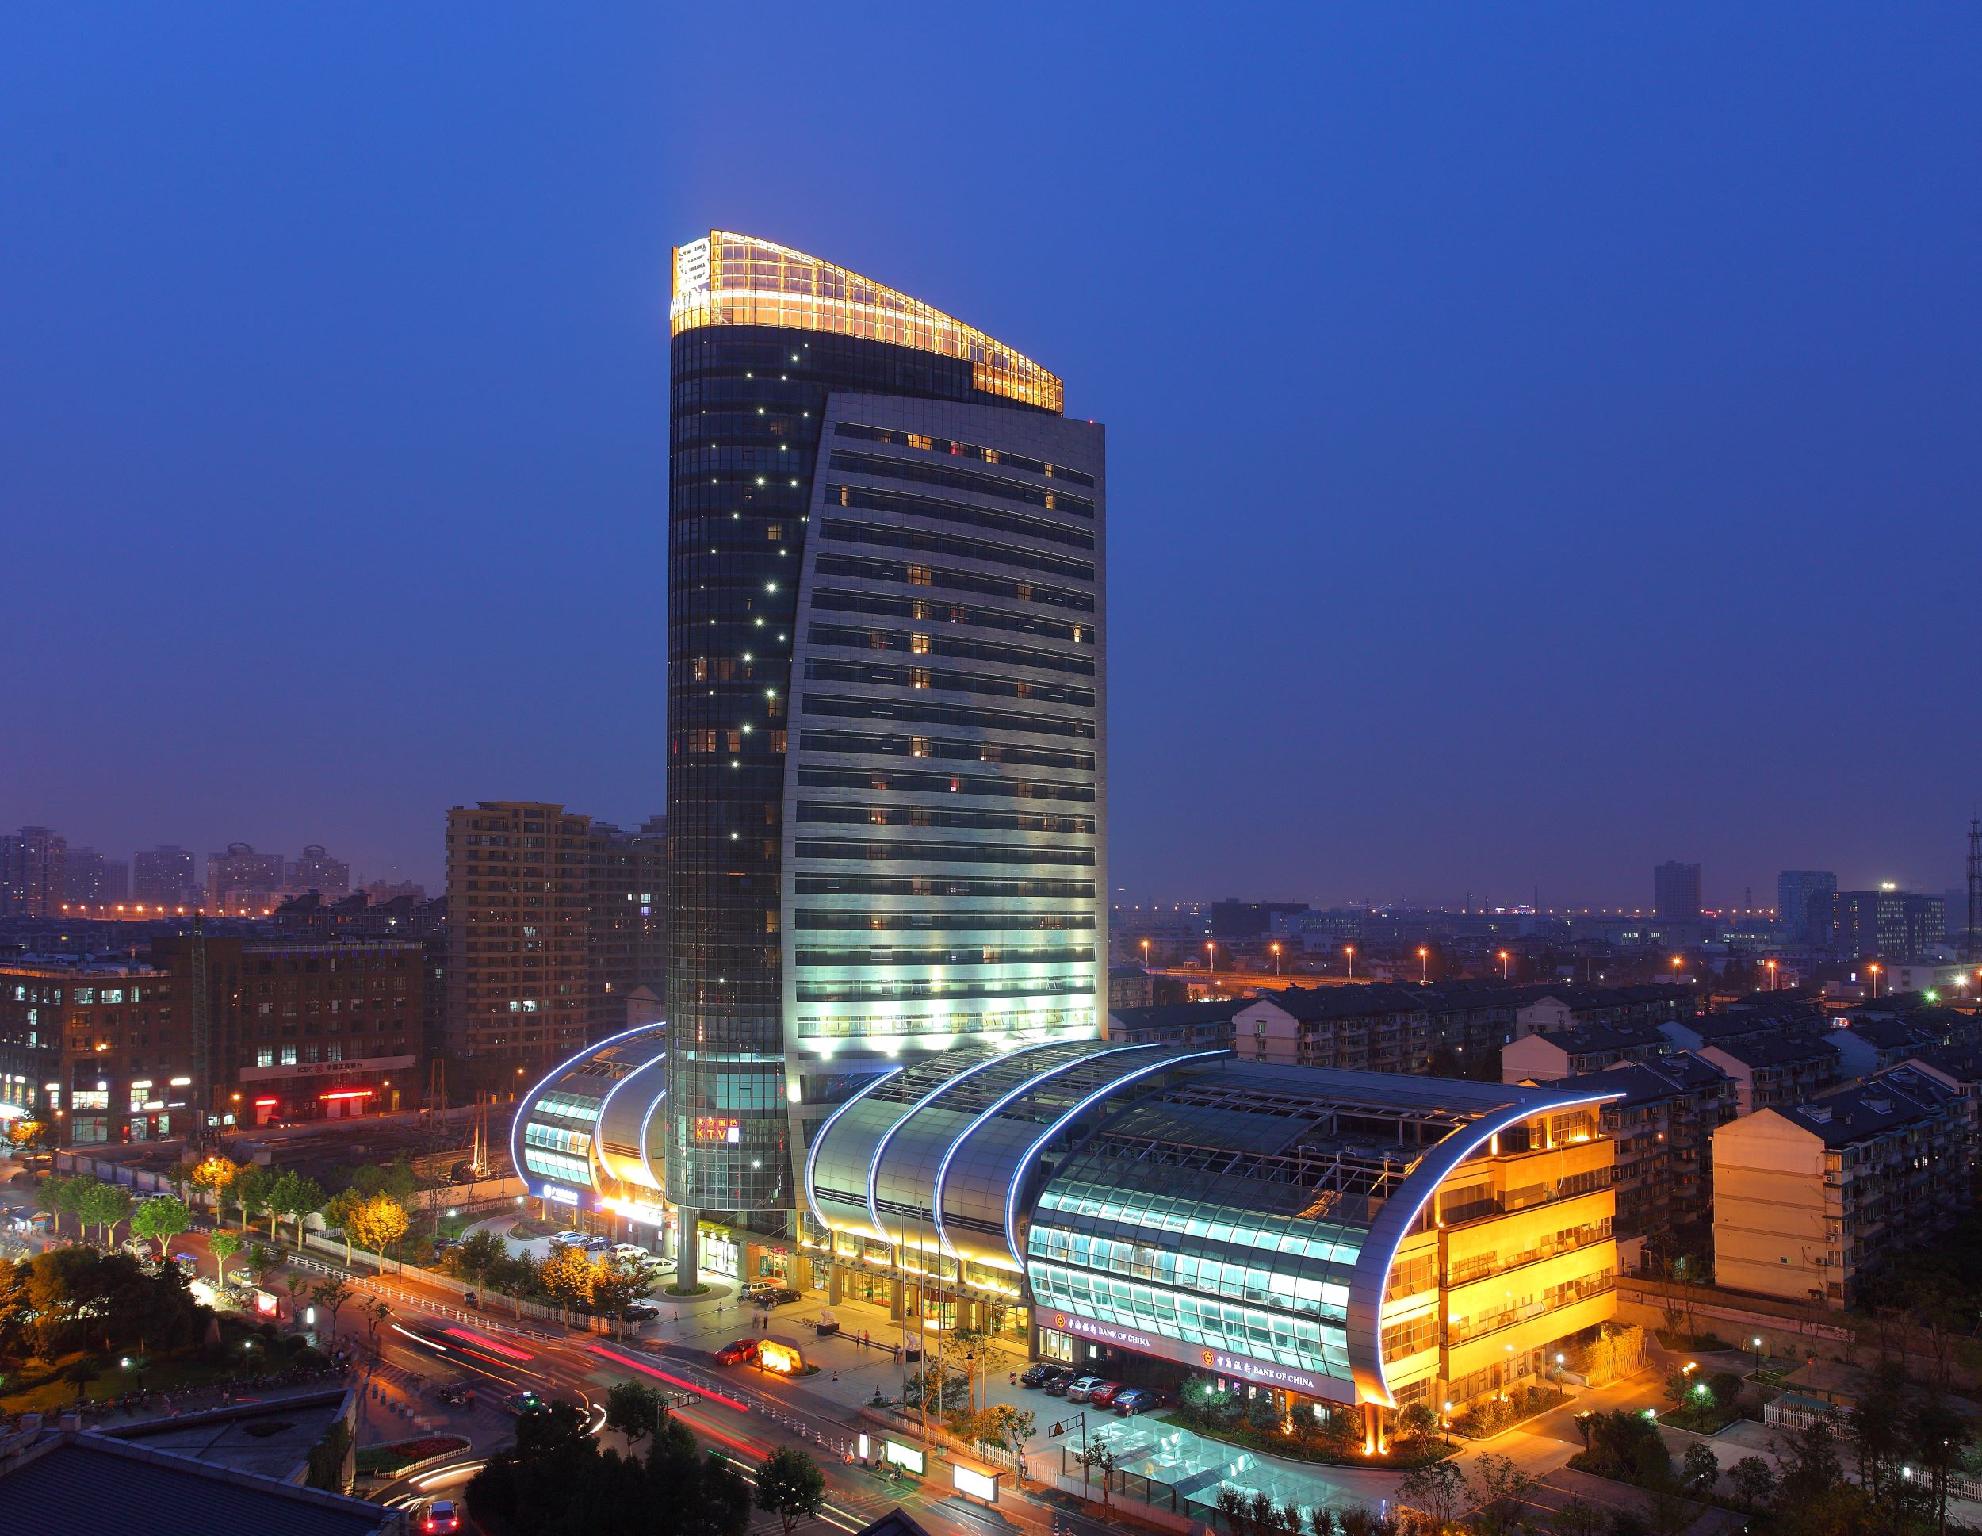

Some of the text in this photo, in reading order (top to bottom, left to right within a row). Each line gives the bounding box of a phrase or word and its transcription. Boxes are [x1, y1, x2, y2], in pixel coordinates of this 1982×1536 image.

[696, 1129, 727, 1140] KTV
[1099, 1327, 1117, 1339] BANK
[1118, 1332, 1127, 1341] OF
[1128, 1334, 1151, 1347] CHINA
[1253, 1365, 1275, 1378] BANK
[1275, 1372, 1287, 1381] OF
[1288, 1375, 1315, 1388] CHINA
